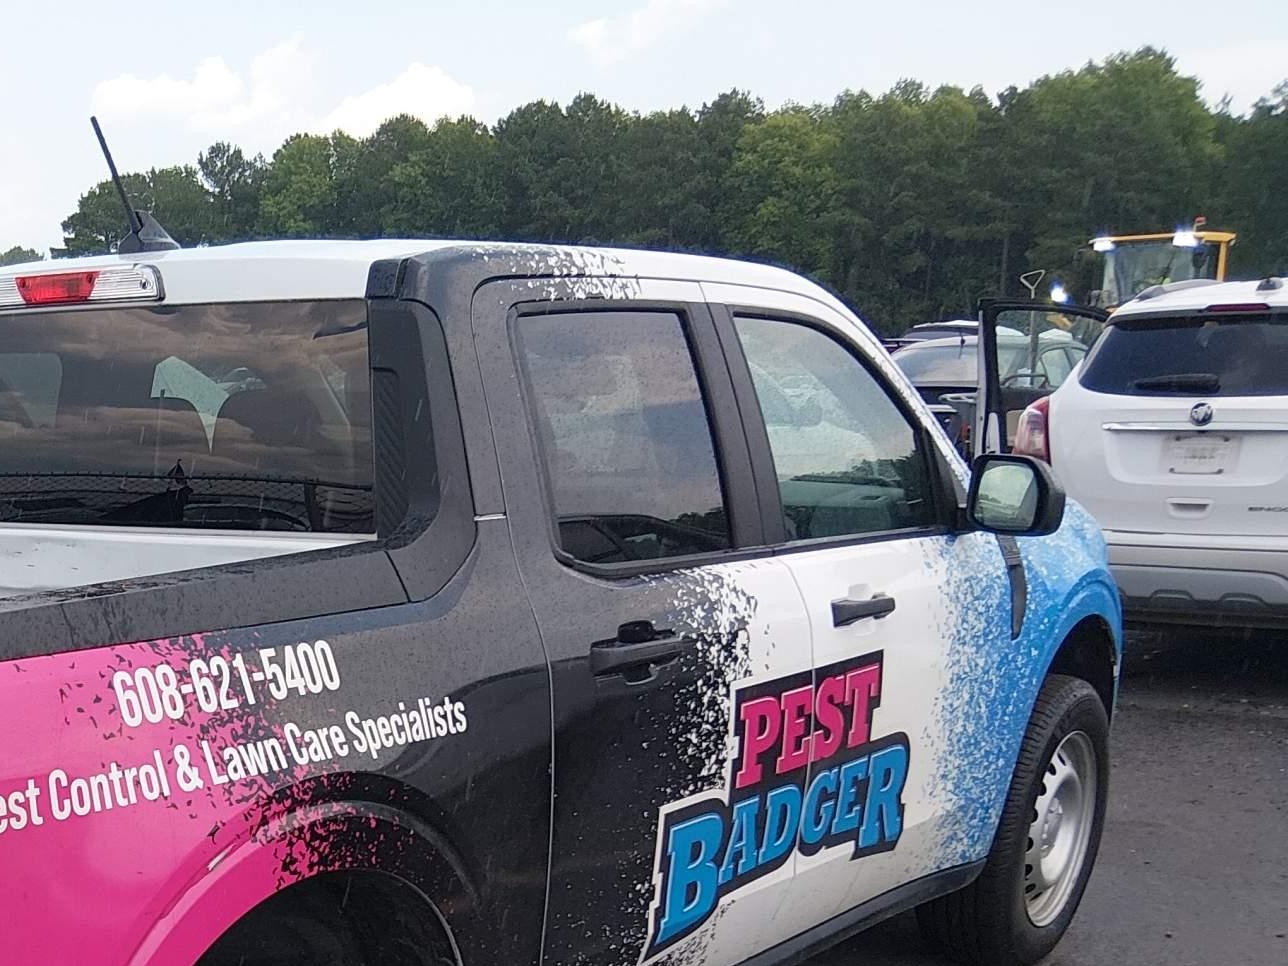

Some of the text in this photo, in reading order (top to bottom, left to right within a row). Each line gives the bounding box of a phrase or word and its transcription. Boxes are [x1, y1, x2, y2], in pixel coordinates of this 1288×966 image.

[113, 640, 341, 728] 608-621-5400
[736, 663, 880, 789] PEST
[48, 756, 169, 822] Control
[175, 744, 204, 792] &
[210, 727, 289, 786] Lawn
[291, 715, 346, 763] Care
[345, 696, 468, 758] Specialists
[654, 743, 908, 947] BADGER
